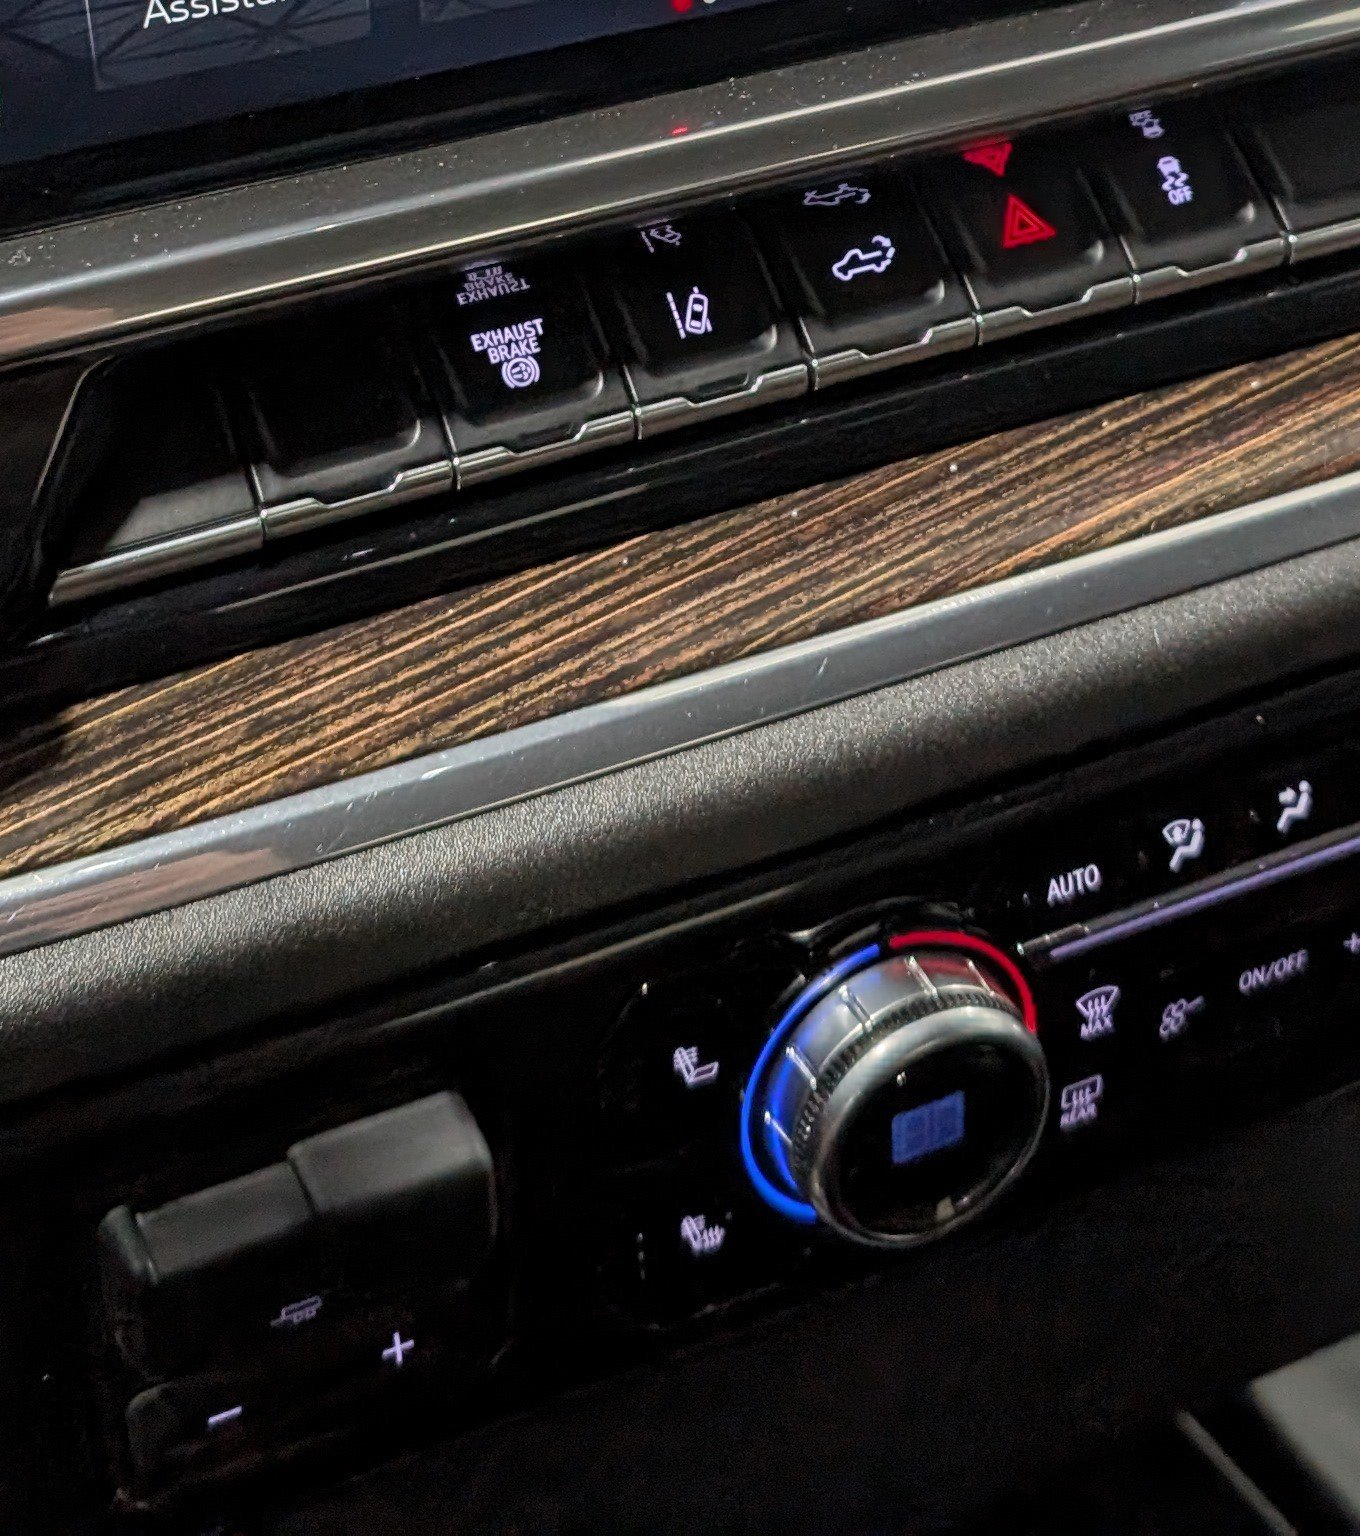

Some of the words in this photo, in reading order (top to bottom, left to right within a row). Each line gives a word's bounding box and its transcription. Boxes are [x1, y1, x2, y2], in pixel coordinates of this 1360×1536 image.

[1168, 185, 1193, 205] OFF
[470, 317, 544, 352] EXHAUST
[487, 336, 541, 364] BRAKE
[1047, 863, 1101, 907] AUTO
[1238, 949, 1309, 994] ON/OFF
